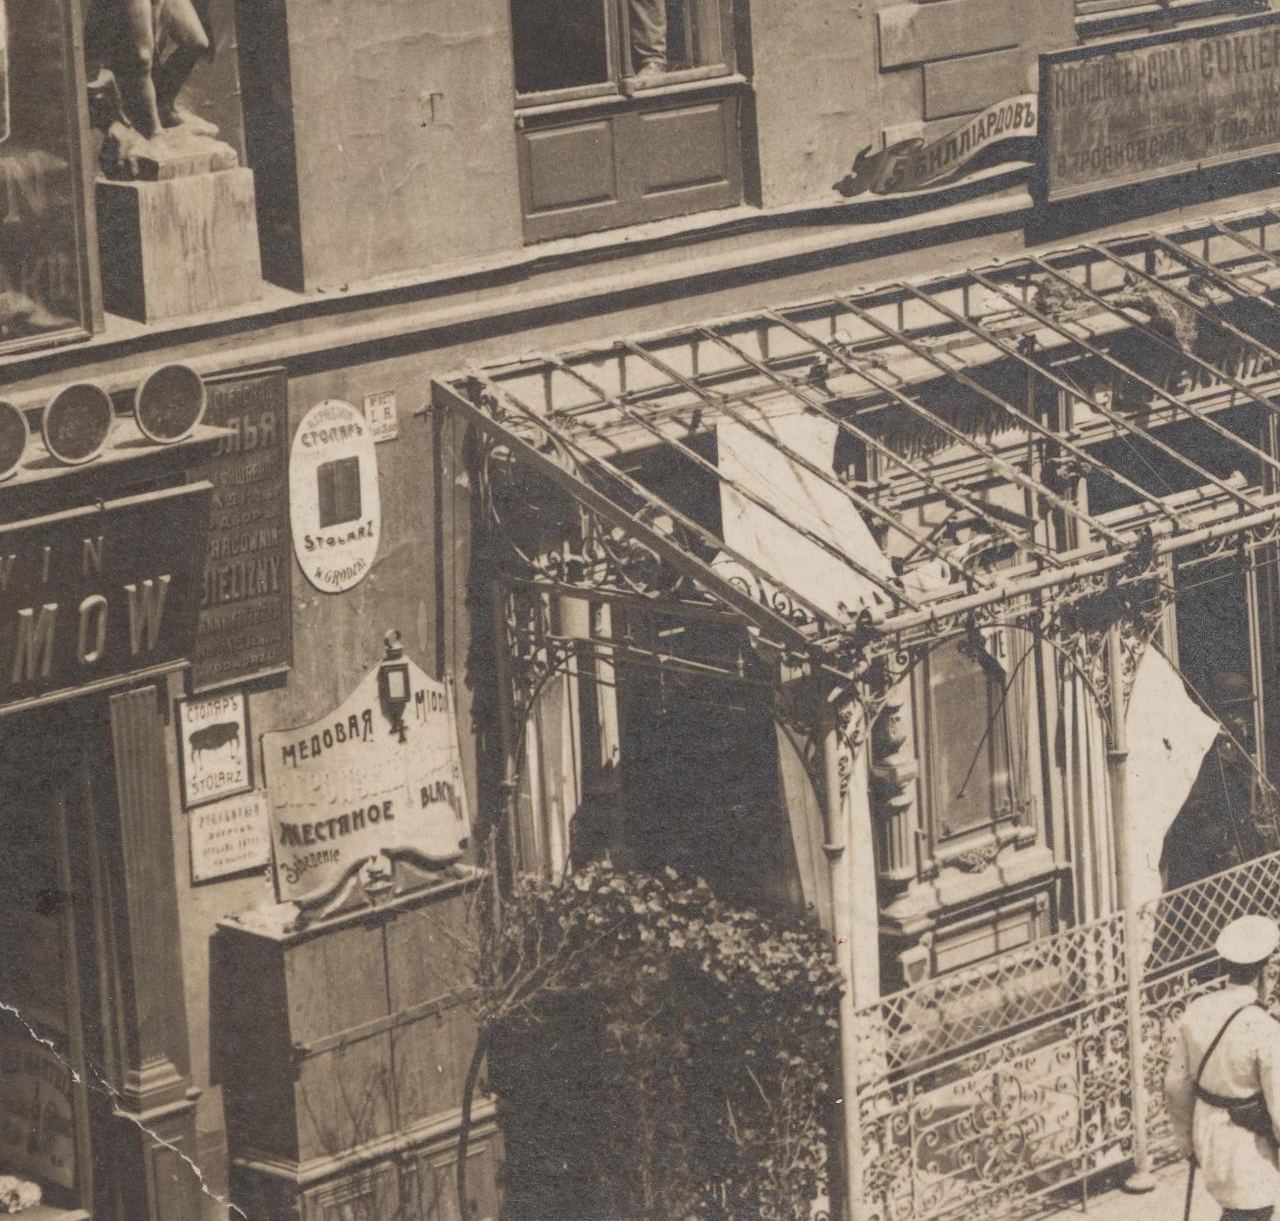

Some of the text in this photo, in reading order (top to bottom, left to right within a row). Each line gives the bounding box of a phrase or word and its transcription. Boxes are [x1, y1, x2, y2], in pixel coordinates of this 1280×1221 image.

[304, 519, 374, 552] STOLARZ
[186, 695, 240, 723] СТОЛЯРЪ
[281, 708, 374, 769] МЕДОВАЯ
[190, 770, 243, 796] STOLARZ
